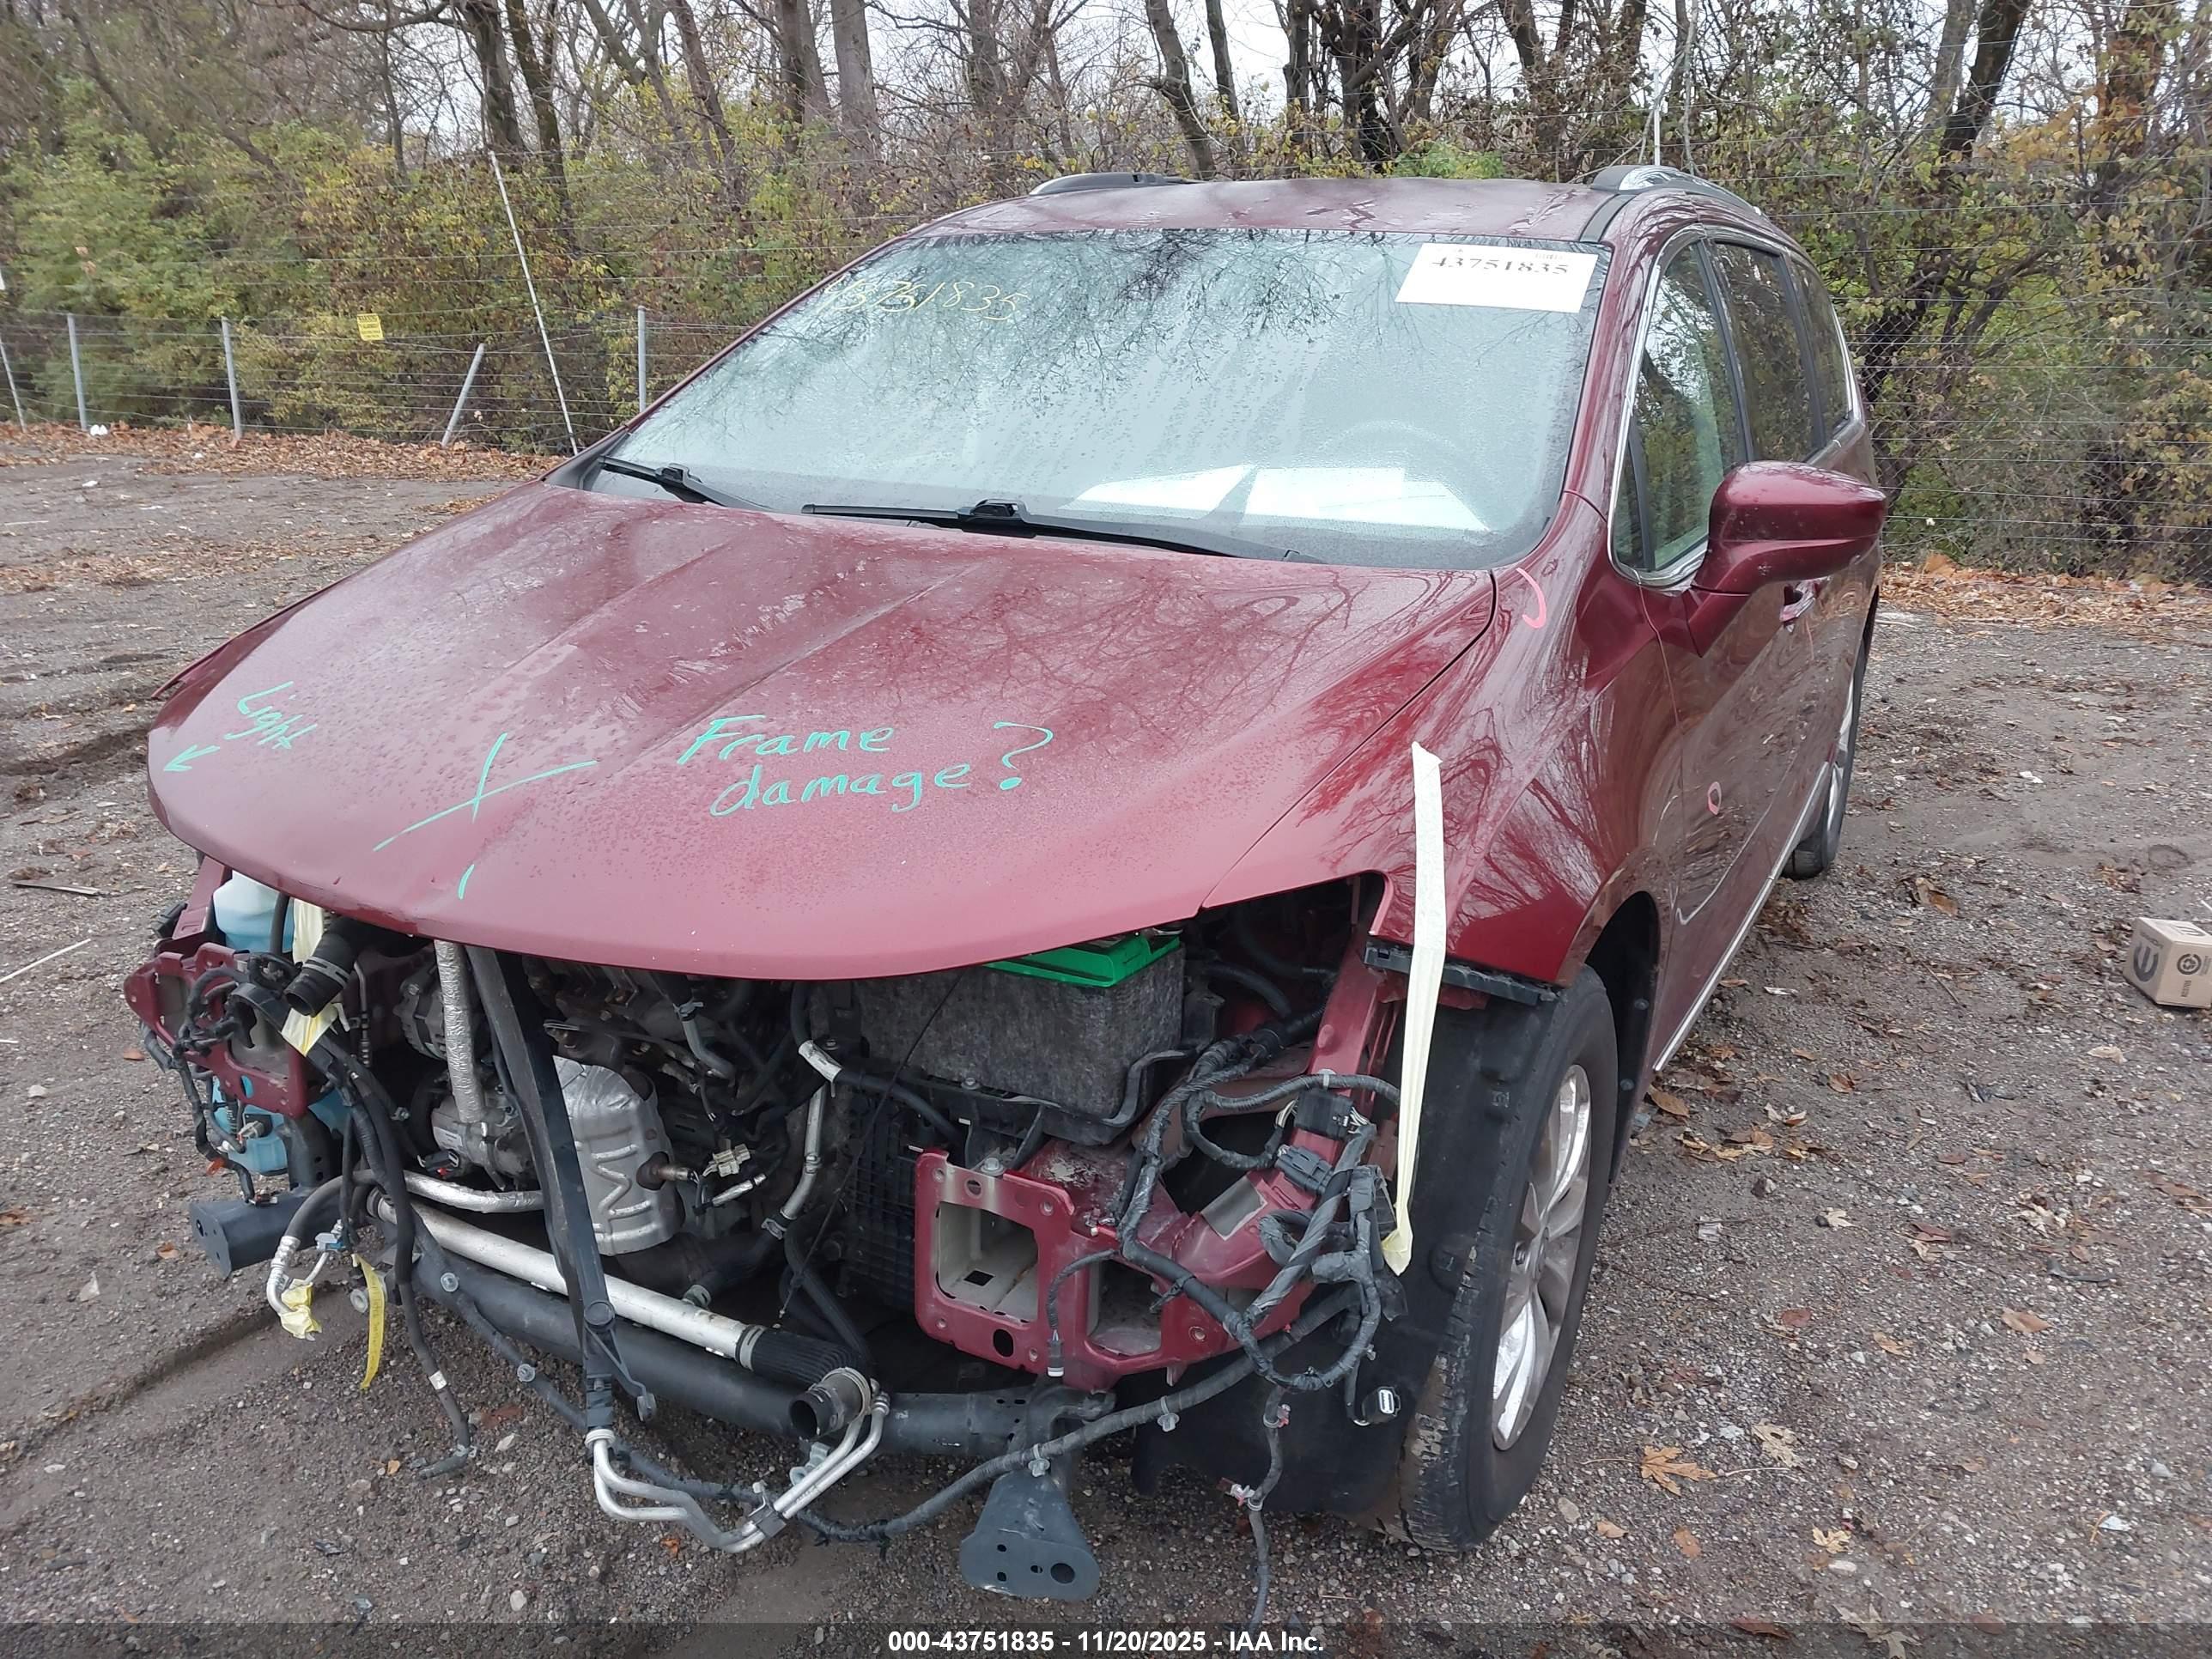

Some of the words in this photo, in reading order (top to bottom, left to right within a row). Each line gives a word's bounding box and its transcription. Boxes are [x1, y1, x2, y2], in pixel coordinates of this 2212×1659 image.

[1431, 257, 1569, 275] 43751835
[677, 714, 896, 765] Frame
[709, 764, 971, 817] damage
